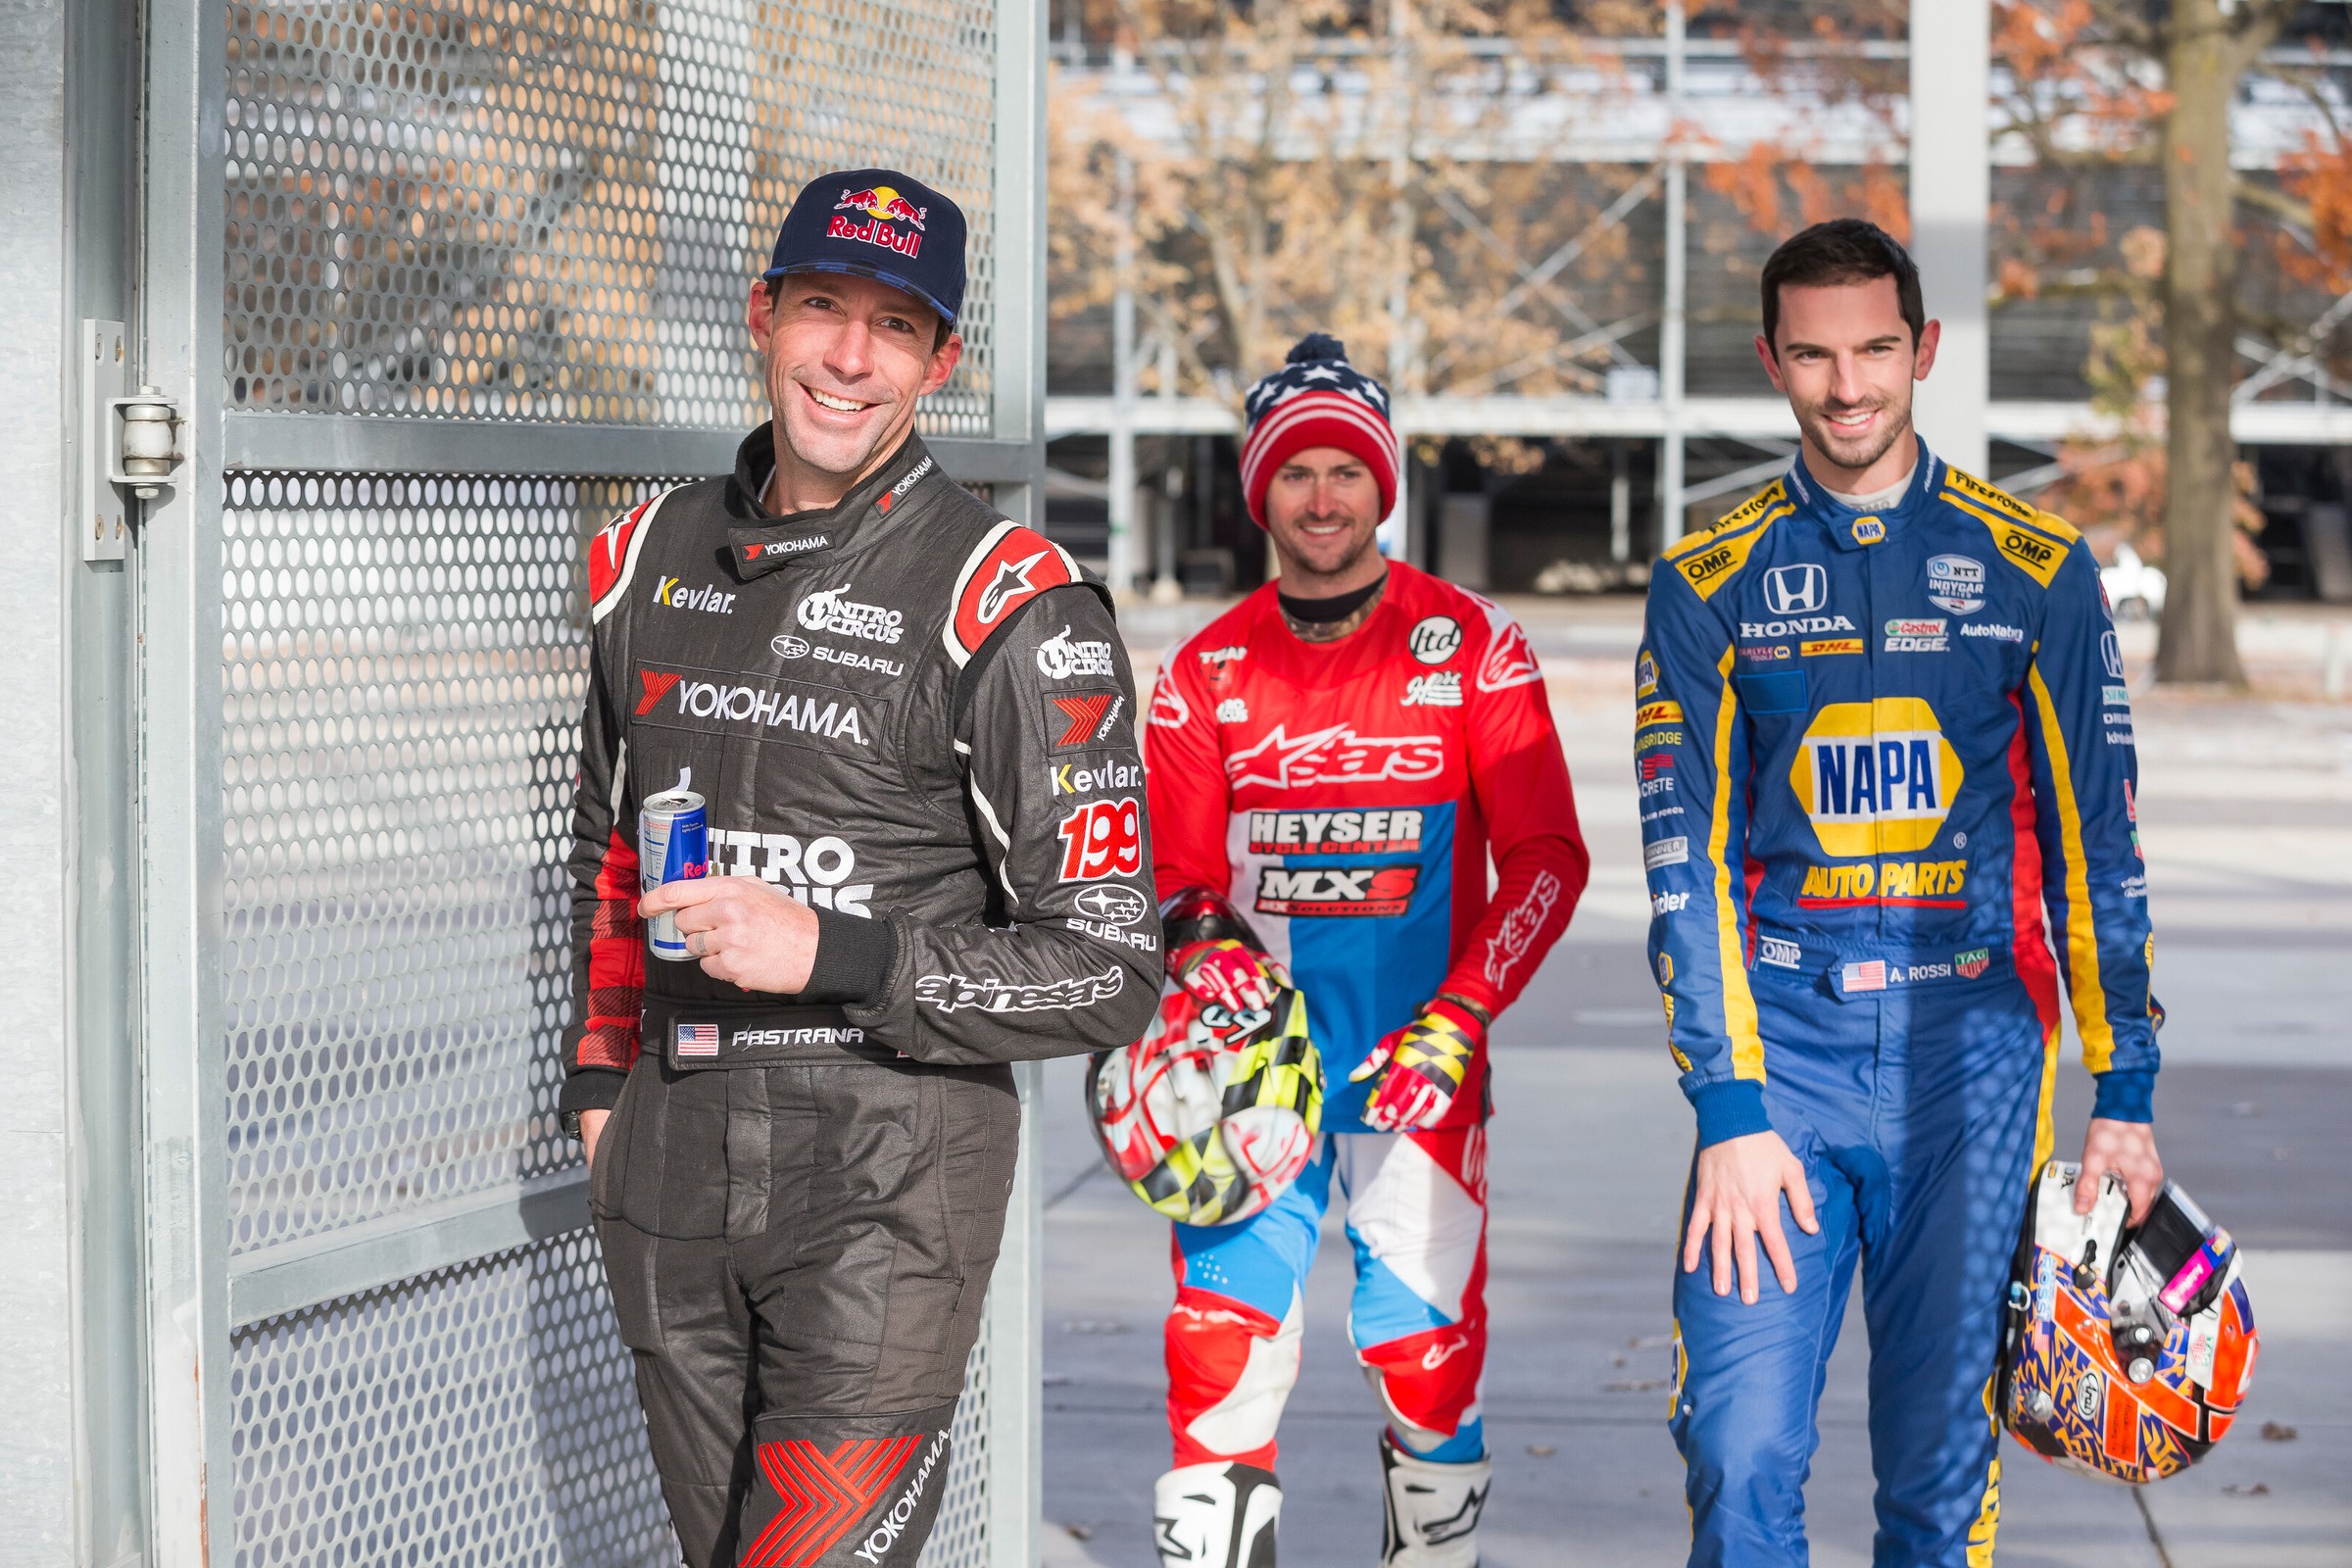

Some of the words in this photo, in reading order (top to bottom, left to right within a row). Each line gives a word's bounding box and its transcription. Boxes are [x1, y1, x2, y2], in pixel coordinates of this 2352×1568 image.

[827, 216, 877, 243] Red
[873, 221, 922, 259] Bull
[764, 535, 828, 556] YOKOHAMA
[1856, 523, 1882, 539] NAPA
[2005, 534, 2052, 563] OMP
[1688, 550, 1732, 579] OMP
[1953, 566, 1979, 577] NTT
[1929, 579, 1984, 594] INDYCAR
[832, 598, 903, 627] NITRO
[1740, 615, 1856, 638] HONDA
[826, 616, 905, 644] CIRCUS
[1900, 622, 1940, 634] Castrol
[1885, 638, 1947, 653] EDGE
[812, 646, 904, 676] SUBARU
[678, 679, 862, 744] YOKOHAMA
[1097, 695, 1125, 742] YOKOHAMA
[1639, 777, 1674, 798] CRETE
[1817, 740, 1936, 814] NAPA
[1057, 797, 1143, 883] 199
[1250, 809, 1424, 844] HEYSER
[1321, 839, 1419, 855] CENTER
[1260, 868, 1418, 901] MXS
[1801, 863, 1875, 898] AUTO
[1877, 859, 1967, 897] PARTS
[1066, 918, 1157, 952] SUBARU
[1762, 942, 1801, 964] OMP
[1957, 951, 1986, 964] TAG
[1889, 966, 1905, 983] A.
[1908, 963, 1951, 981] ROSSI
[731, 1026, 864, 1048] PASTRANA
[2084, 1372, 2098, 1409] Arai
[854, 1428, 951, 1566] YOKOHAMA
